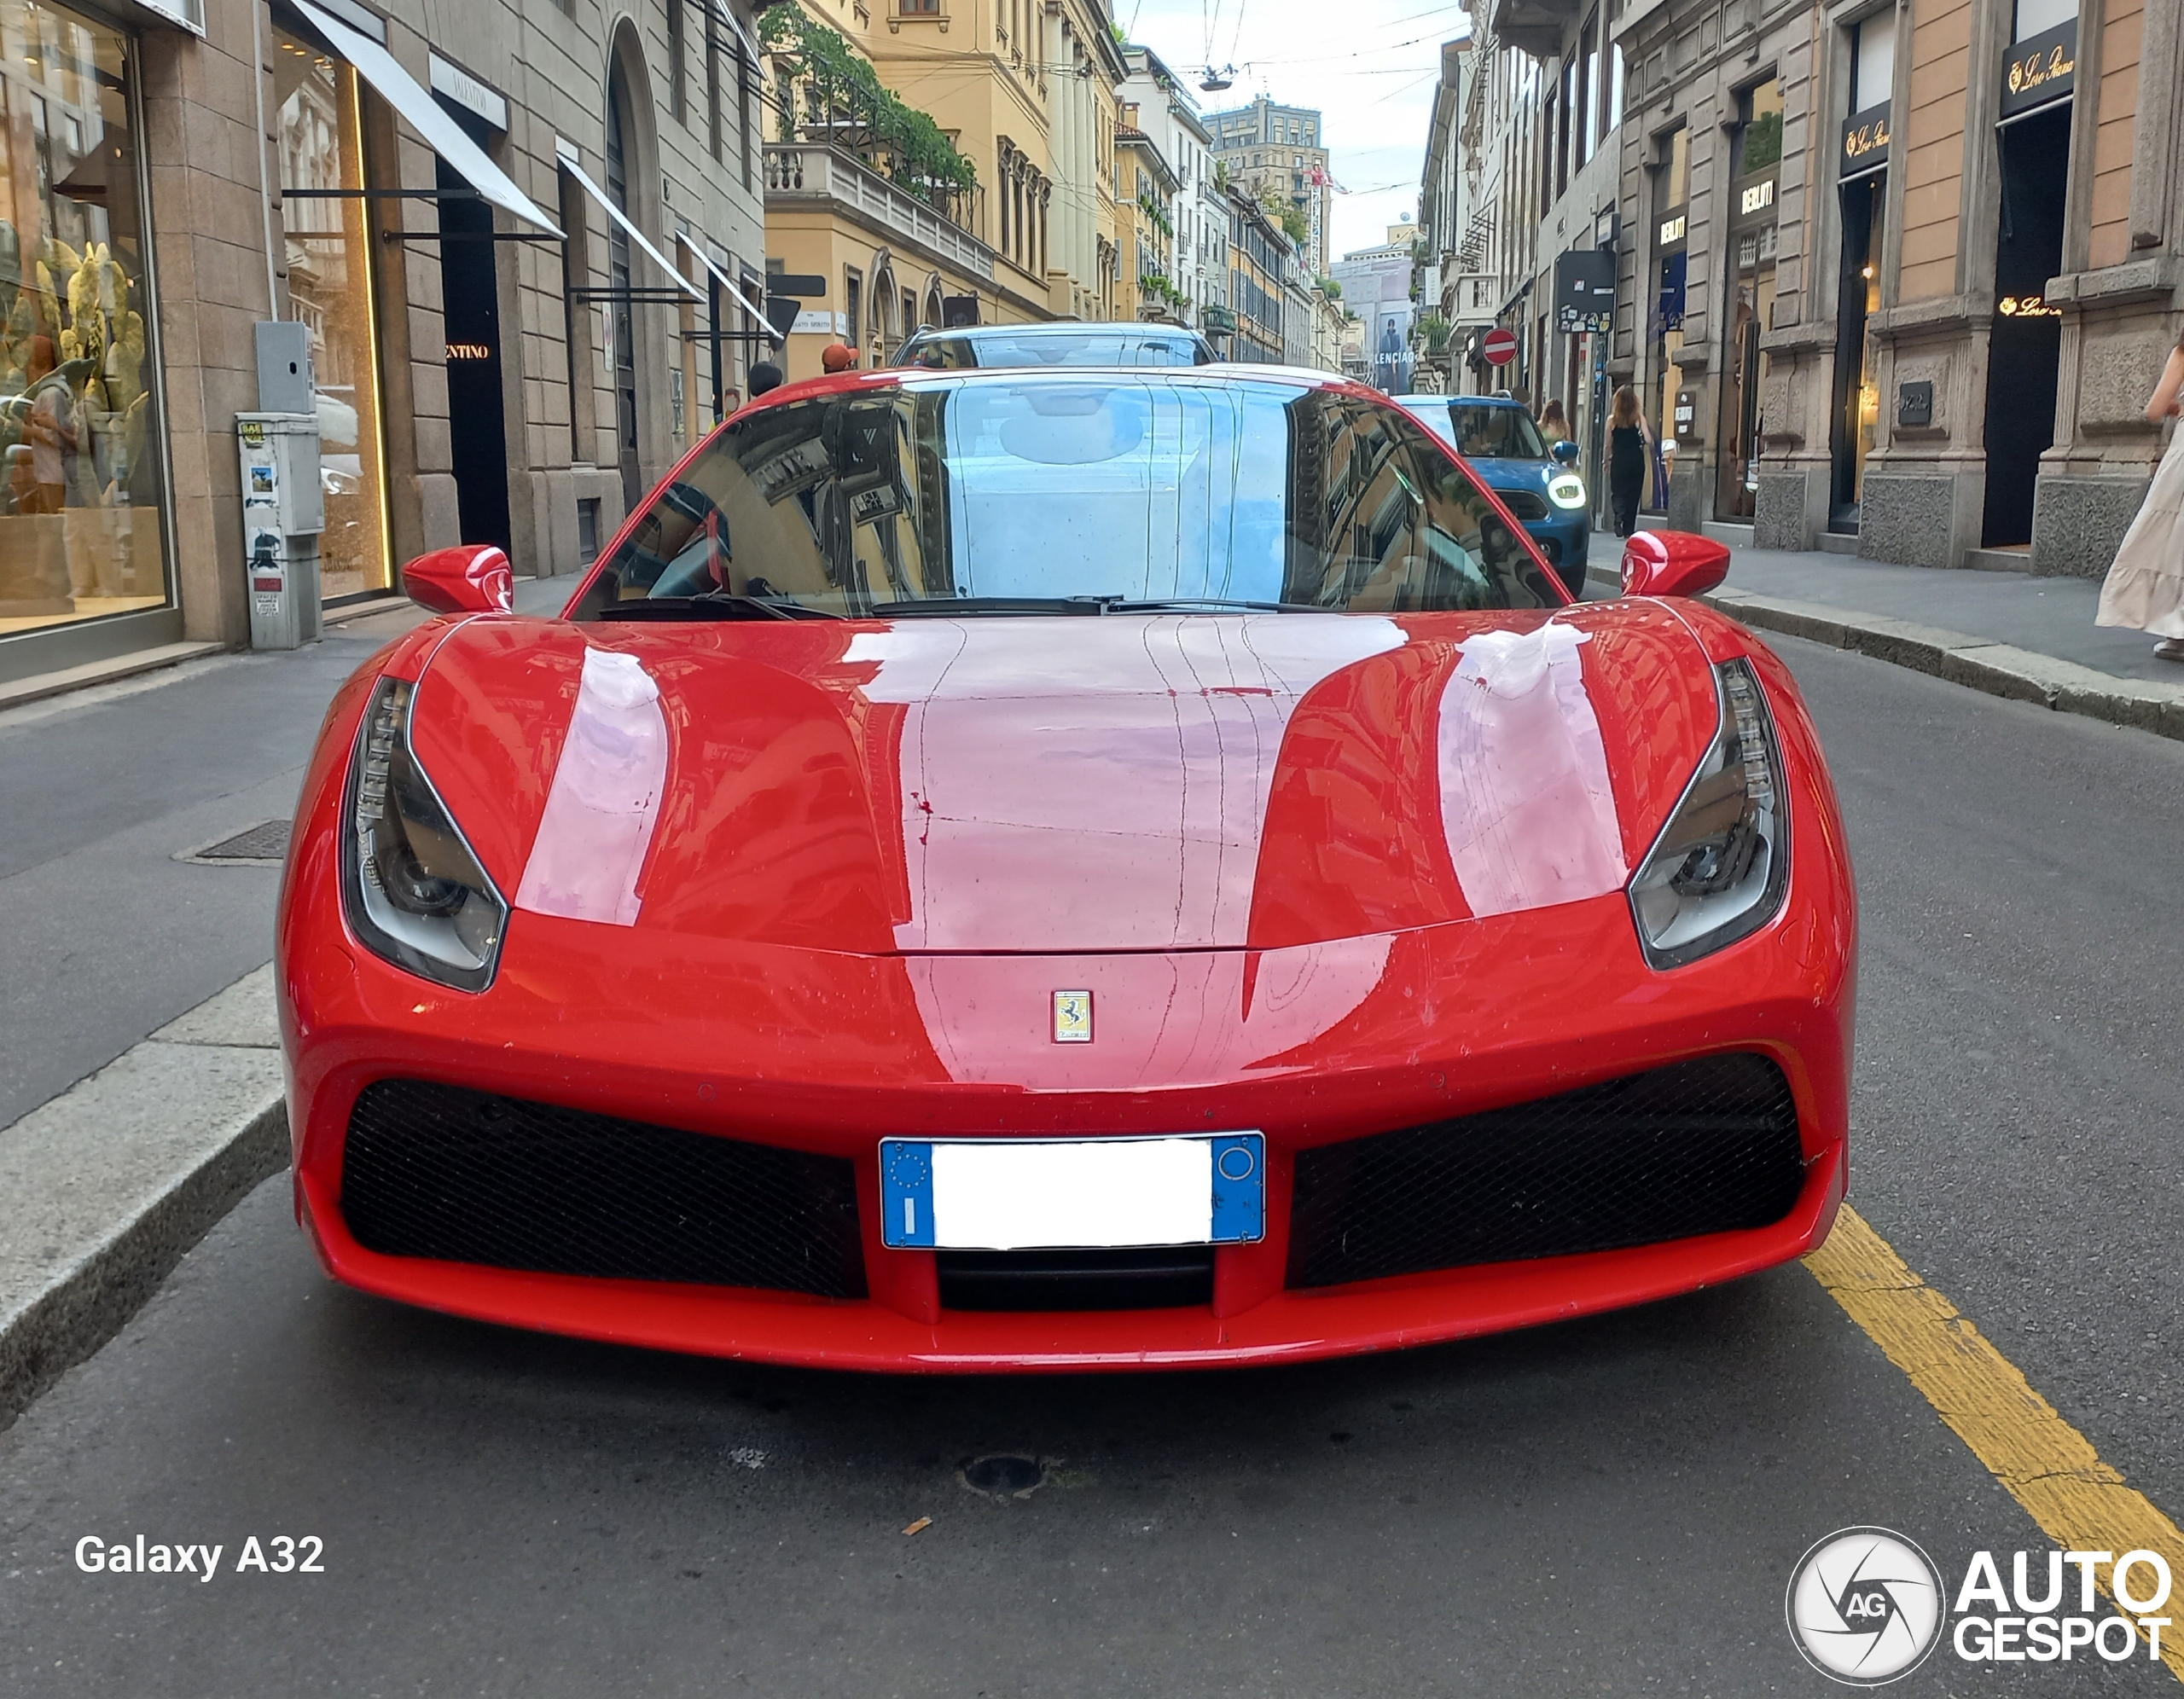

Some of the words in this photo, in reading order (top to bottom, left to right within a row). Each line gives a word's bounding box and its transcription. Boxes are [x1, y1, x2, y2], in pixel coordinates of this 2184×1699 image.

[2020, 52, 2045, 91] Loro
[2046, 44, 2075, 80] Piana
[1854, 124, 1872, 156] Loro
[1742, 179, 1774, 215] BERLUTI
[2015, 296, 2049, 316] Loro
